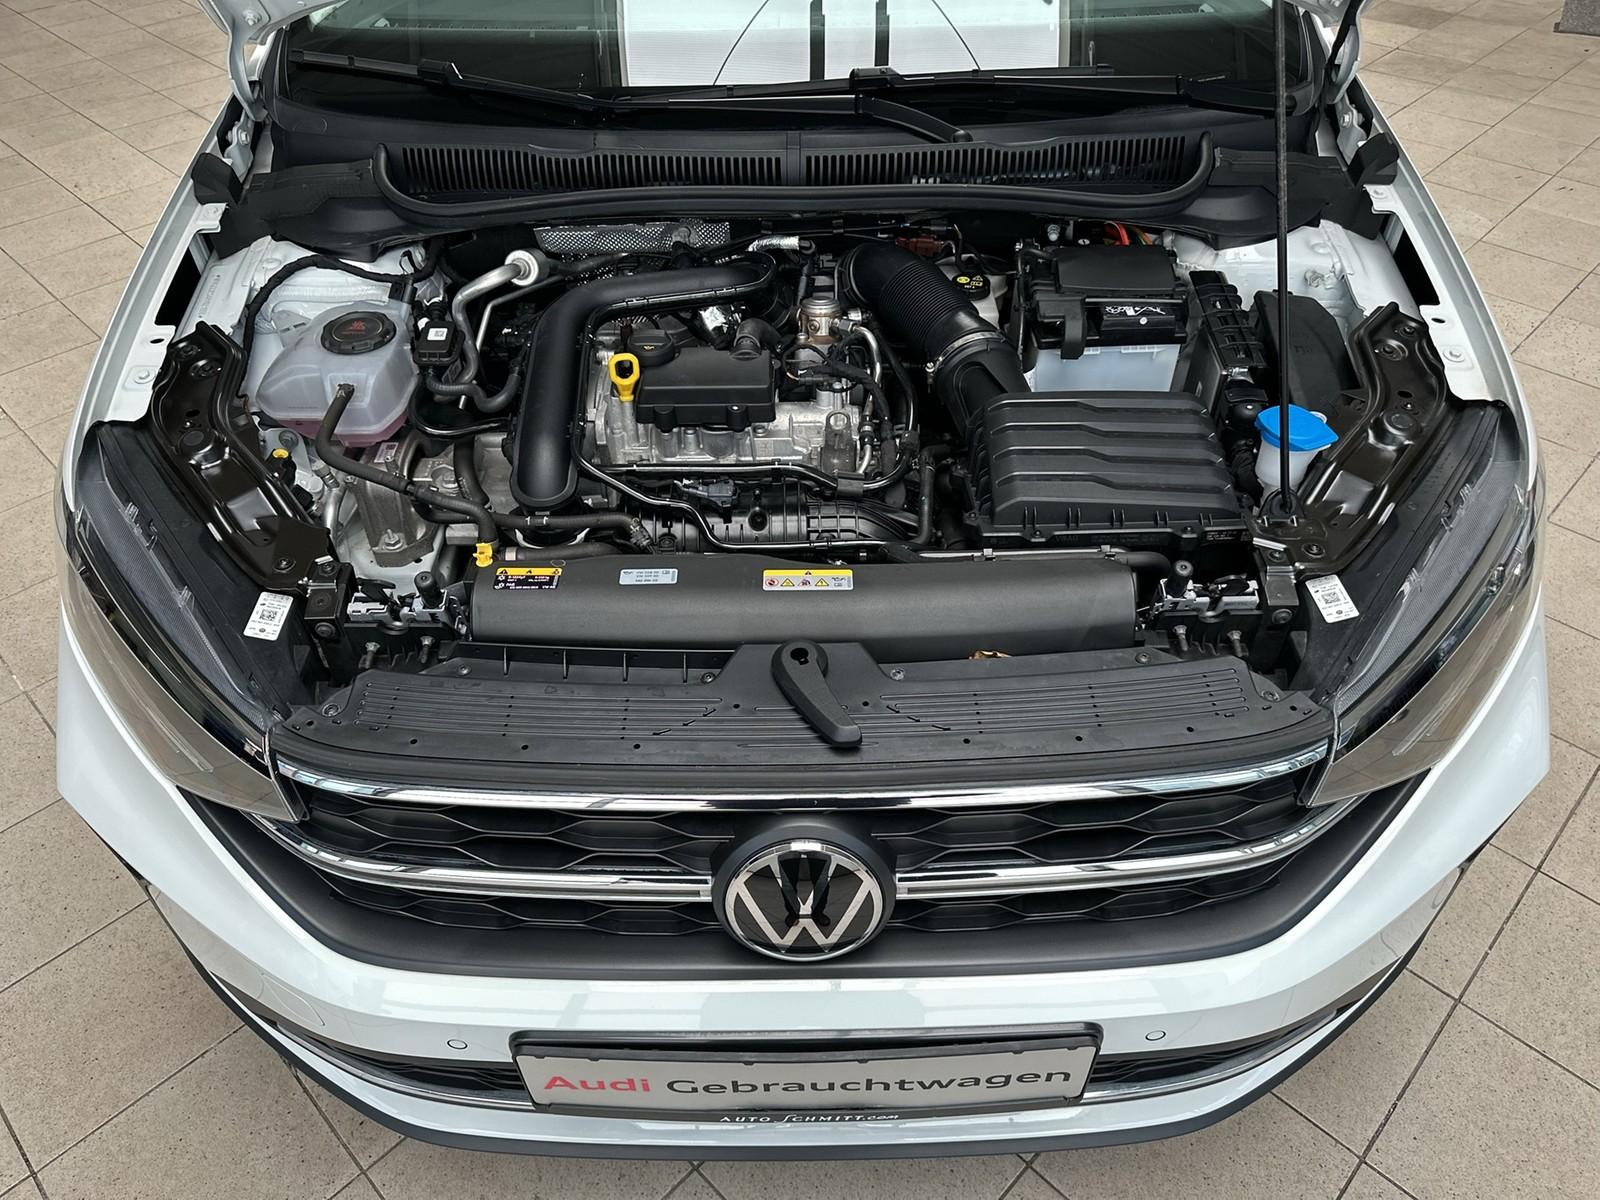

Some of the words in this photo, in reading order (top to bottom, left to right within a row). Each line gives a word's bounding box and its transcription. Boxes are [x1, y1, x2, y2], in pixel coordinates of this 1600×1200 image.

[729, 846, 879, 956] VW
[544, 1076, 651, 1092] Audi
[666, 1071, 1071, 1094] Gebrauchtwagen
[720, 1115, 771, 1123] AUTO
[782, 1114, 899, 1123] SCHMITT.com
